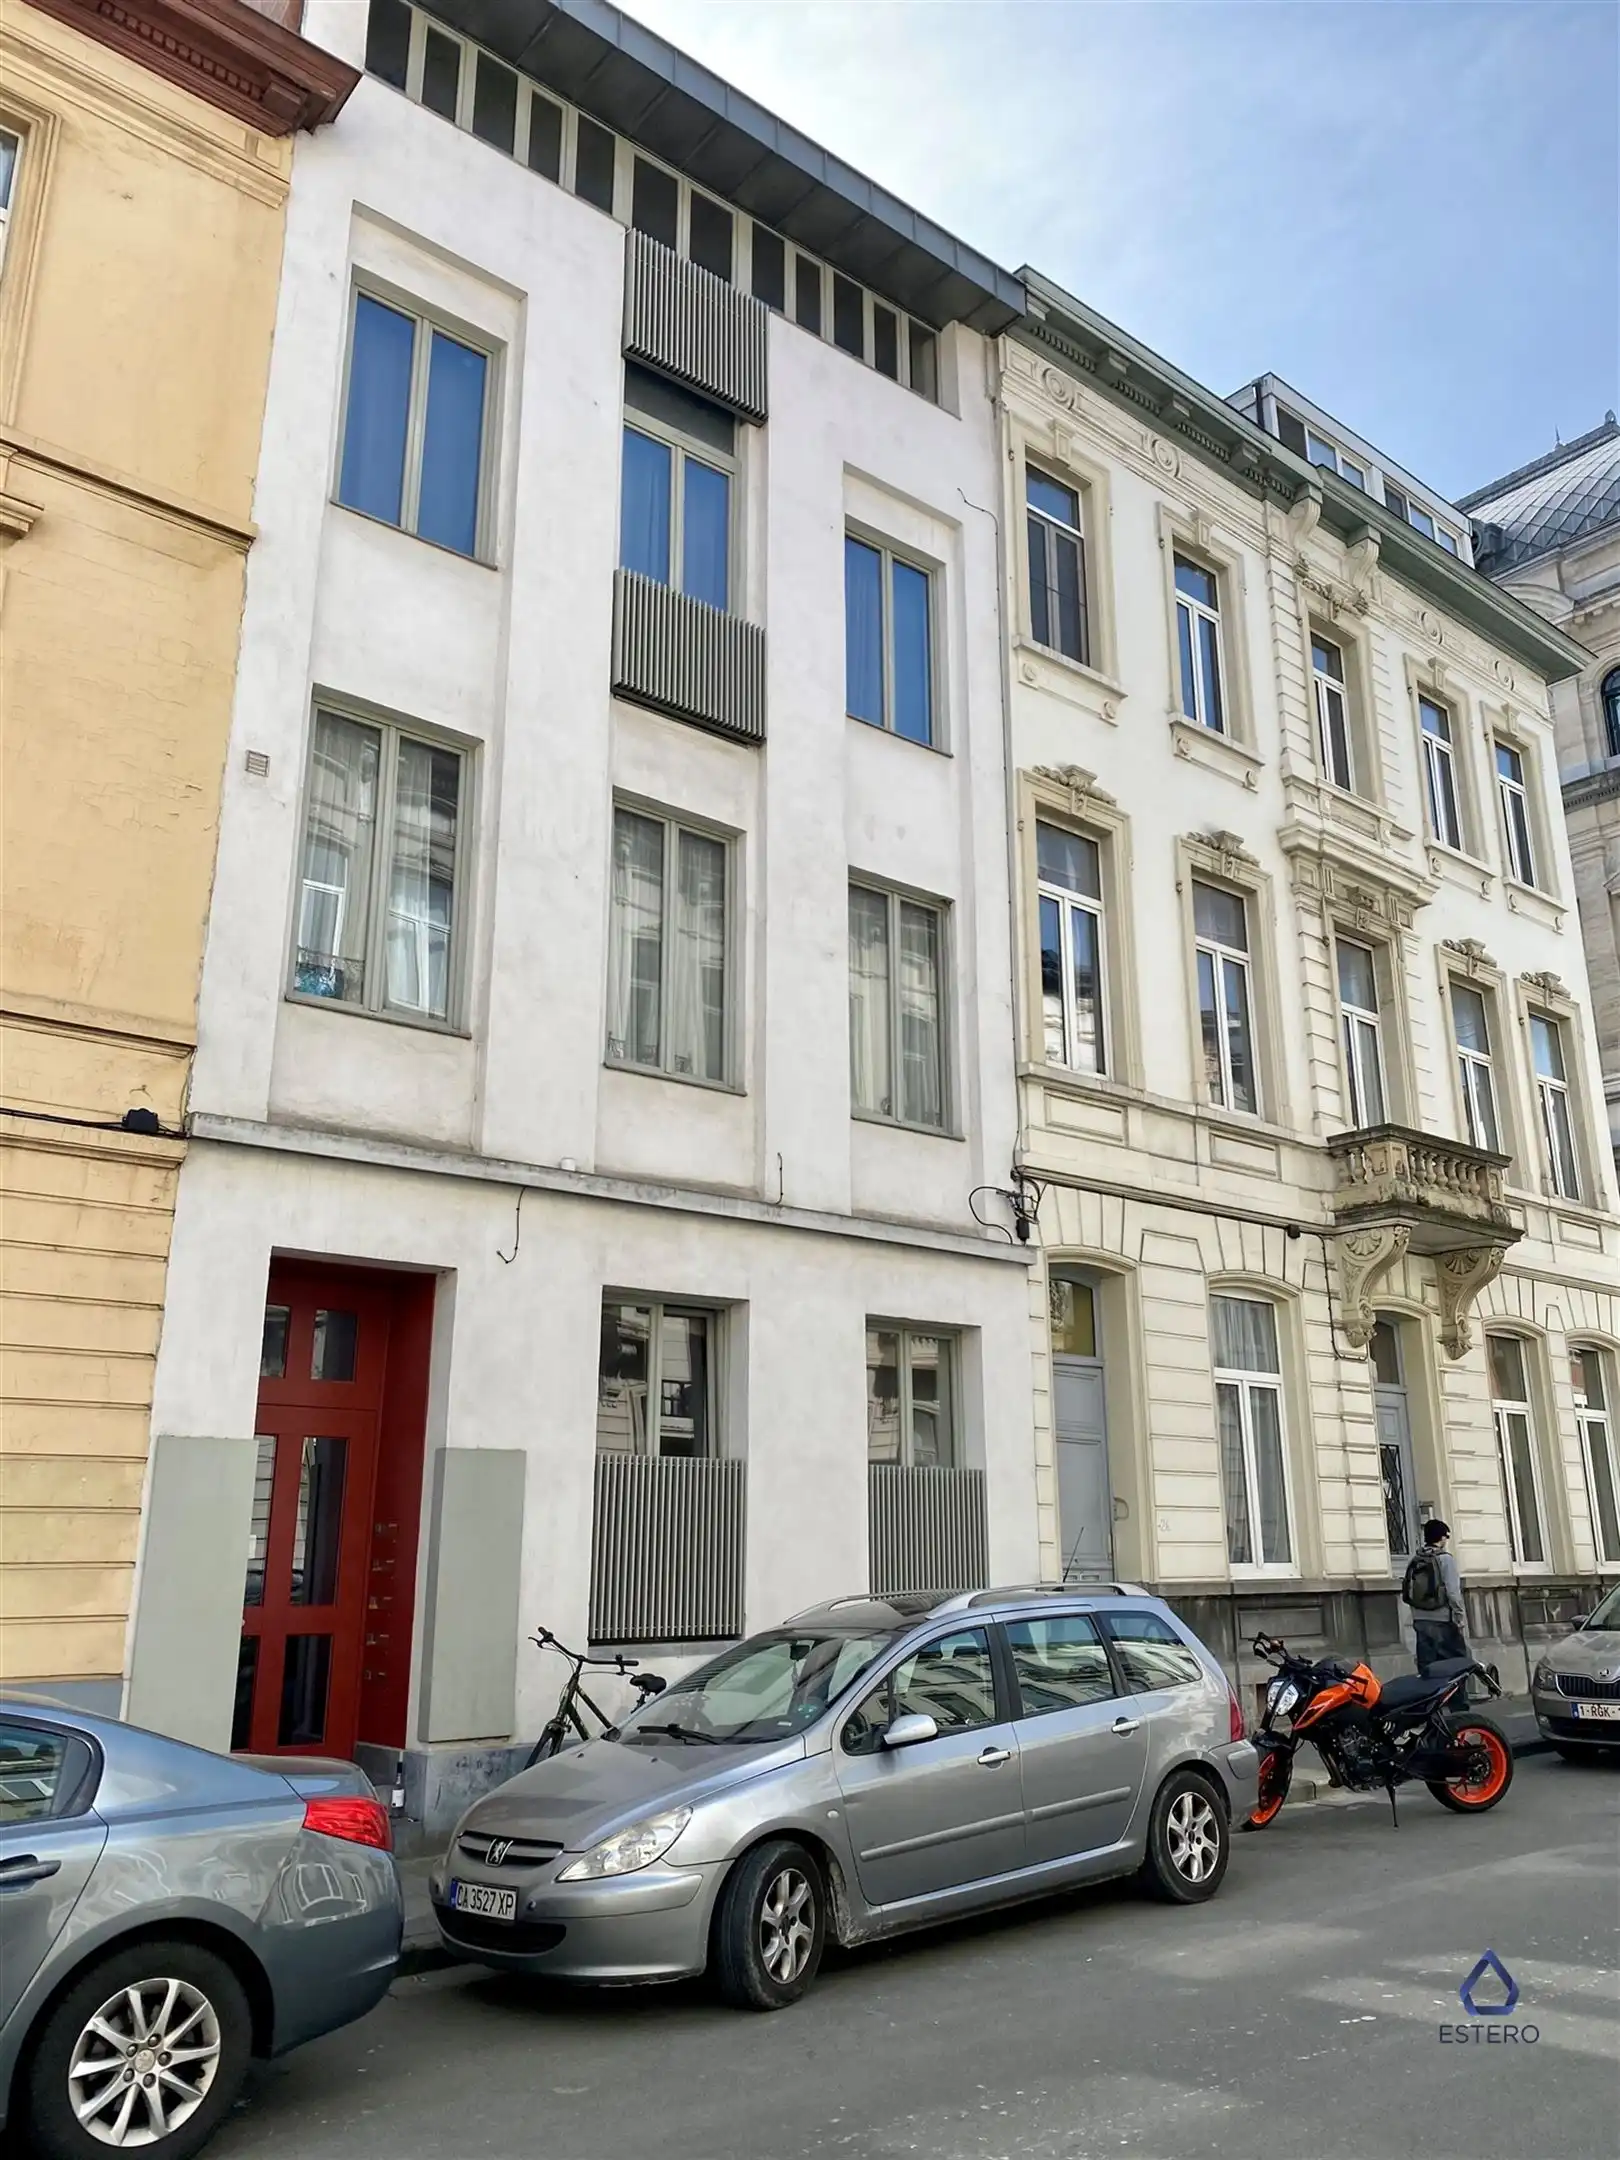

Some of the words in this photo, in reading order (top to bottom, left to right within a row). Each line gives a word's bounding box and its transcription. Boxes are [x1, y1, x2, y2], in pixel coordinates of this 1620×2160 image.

[457, 1885, 468, 1908] CA
[470, 1888, 496, 1913] 3527
[498, 1892, 514, 1915] XP
